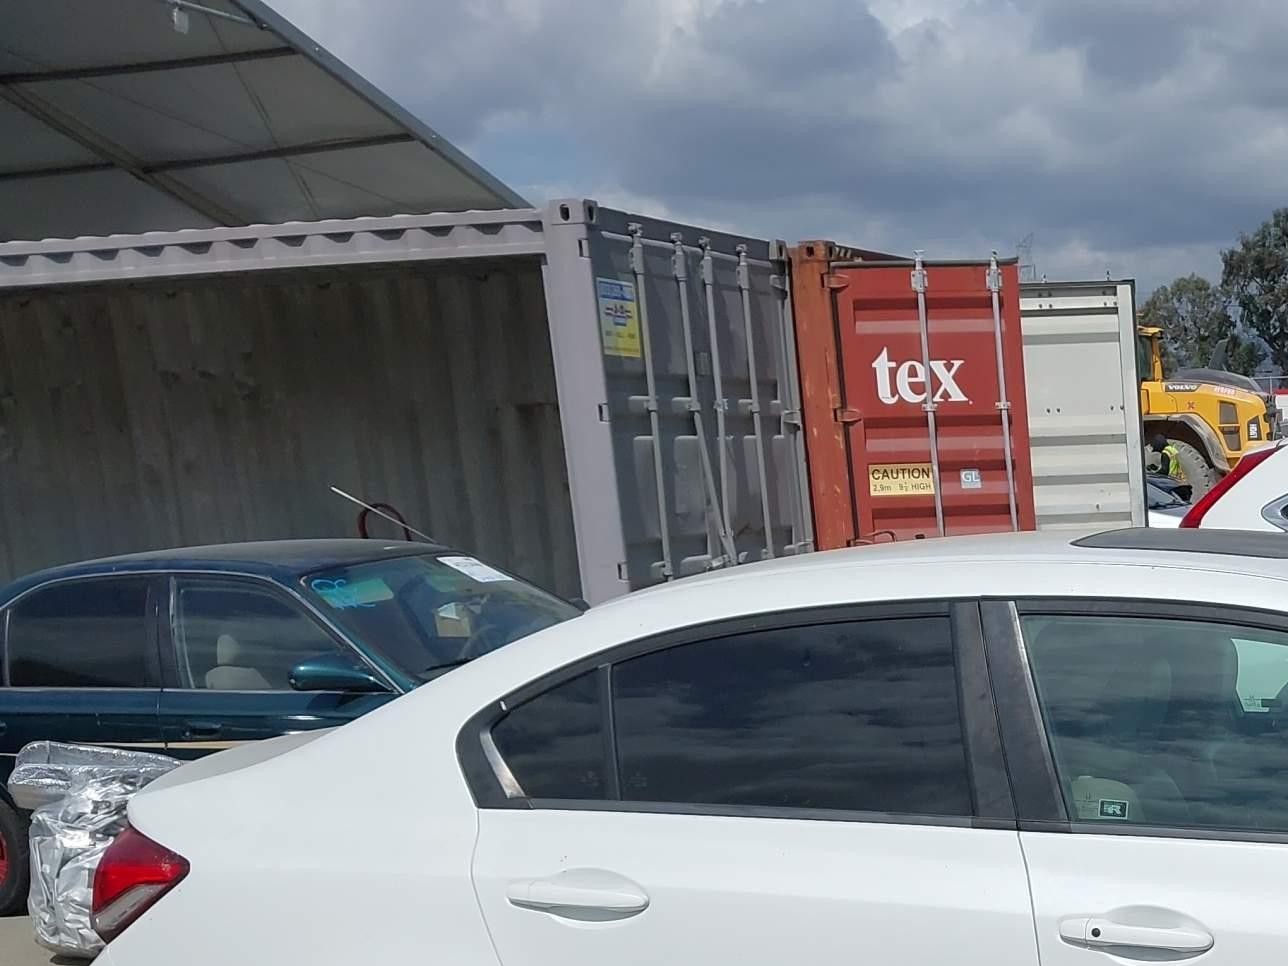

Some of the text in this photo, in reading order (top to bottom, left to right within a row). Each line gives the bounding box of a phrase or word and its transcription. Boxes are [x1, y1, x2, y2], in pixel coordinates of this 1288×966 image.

[871, 346, 969, 404] tex
[871, 468, 930, 480] CAUTION
[911, 482, 931, 491] HIGH
